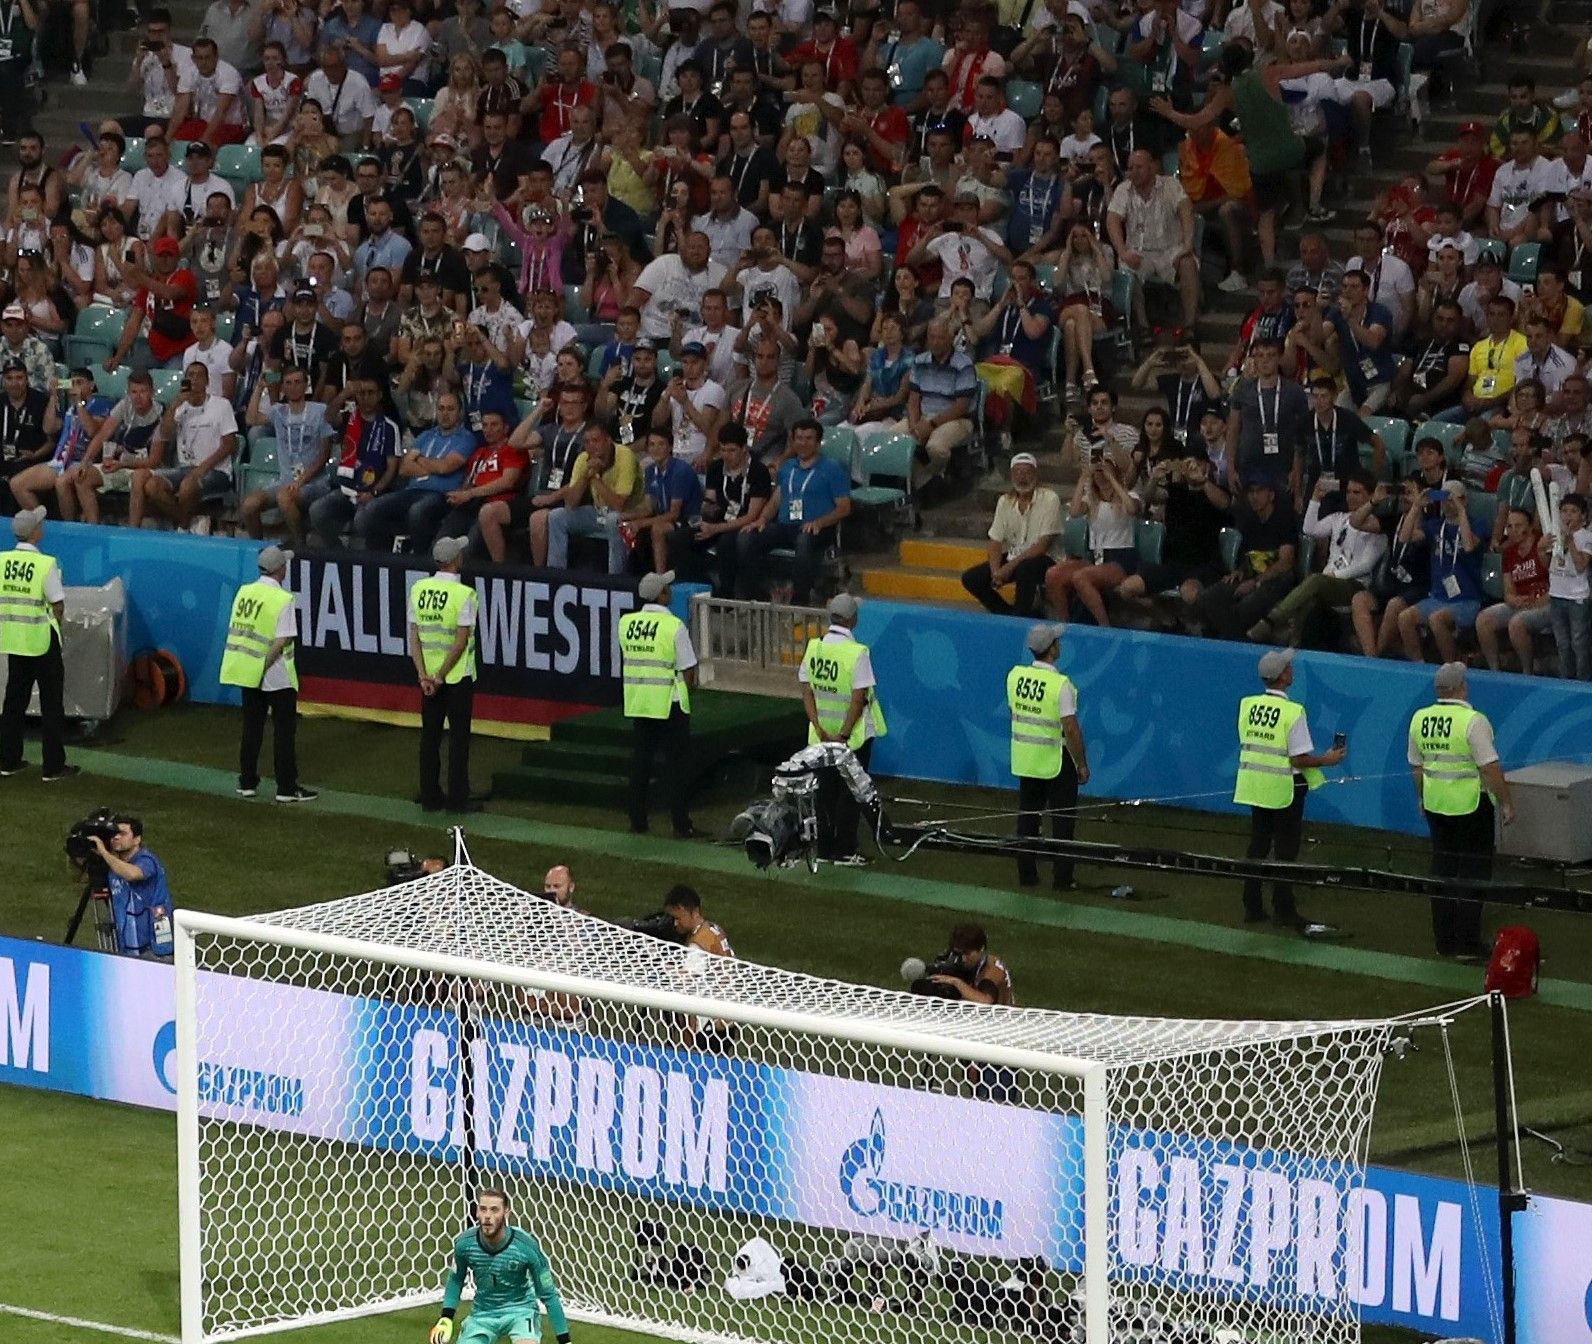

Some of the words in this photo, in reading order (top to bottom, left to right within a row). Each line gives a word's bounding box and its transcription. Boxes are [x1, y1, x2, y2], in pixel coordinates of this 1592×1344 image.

[4, 559, 35, 582] 8546
[418, 588, 448, 611] 8769
[626, 620, 659, 641] 8544
[1016, 675, 1047, 703] 8535
[1248, 703, 1281, 729] 8559
[1421, 715, 1453, 739] 8793
[197, 1059, 305, 1120] GAZPROM
[411, 1028, 731, 1196] GAZPROM
[880, 1176, 1005, 1241] GAZPROM
[1116, 1146, 1464, 1324] GAZPROM
[525, 1317, 532, 1333] 1
